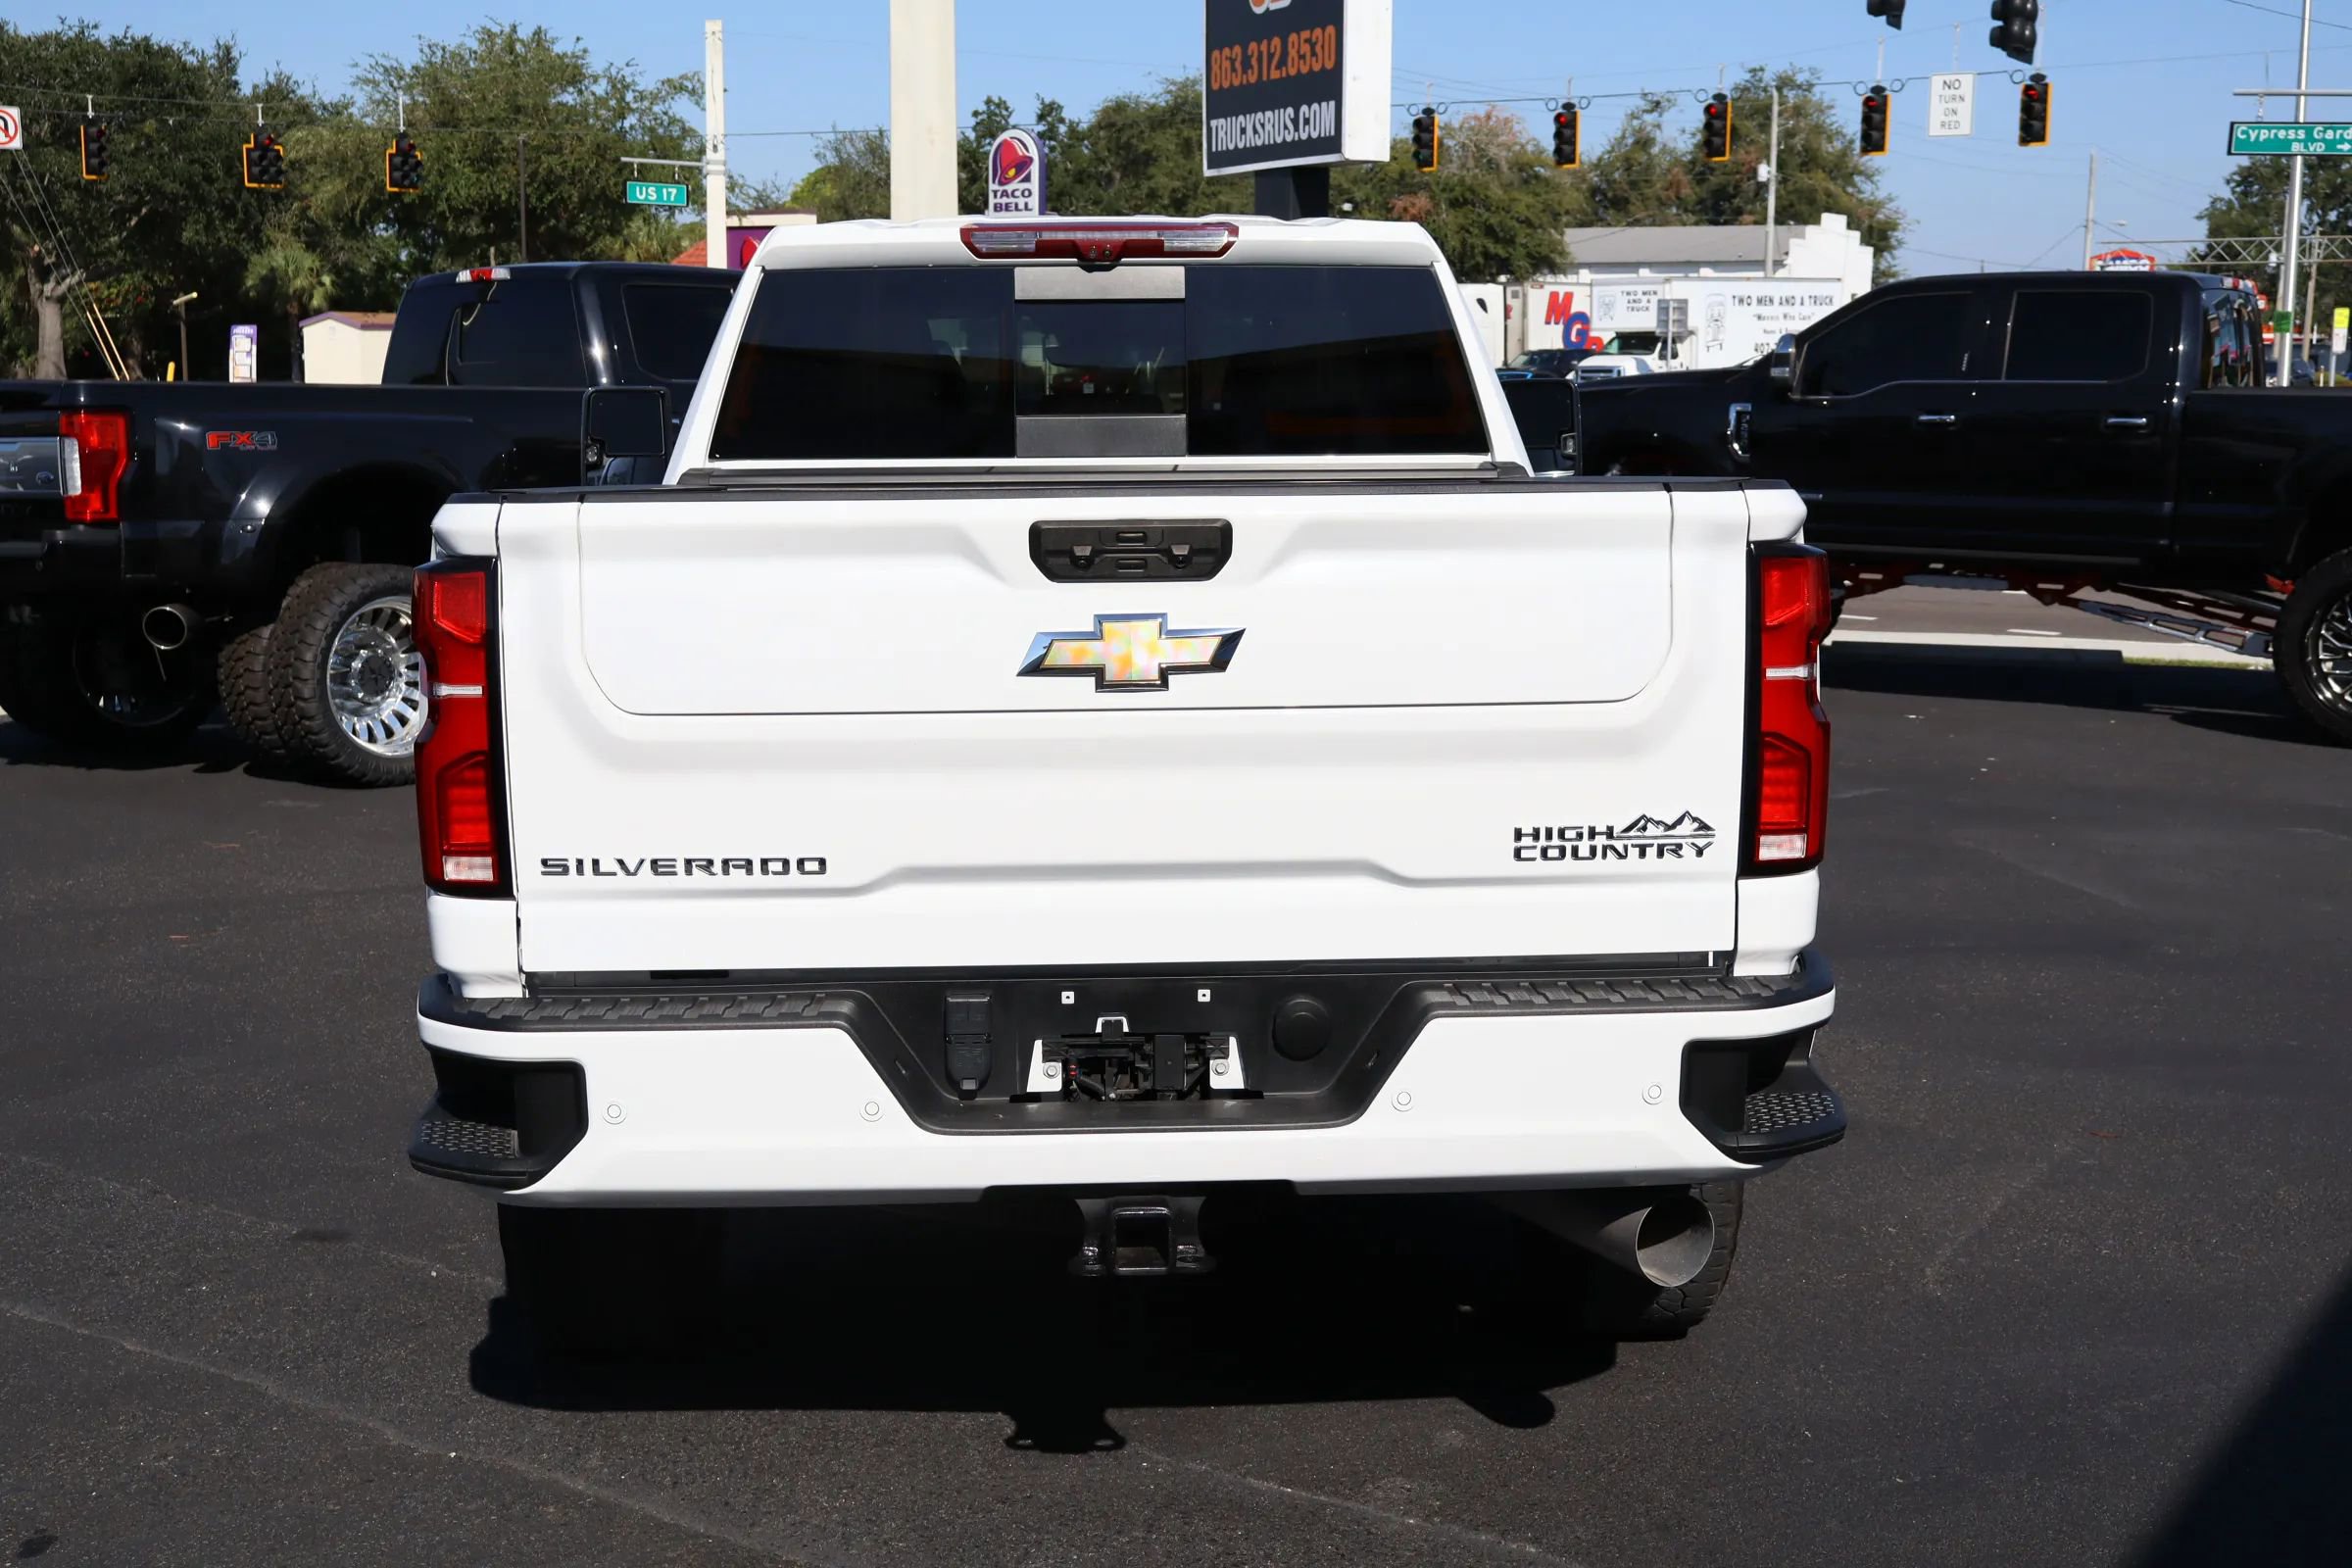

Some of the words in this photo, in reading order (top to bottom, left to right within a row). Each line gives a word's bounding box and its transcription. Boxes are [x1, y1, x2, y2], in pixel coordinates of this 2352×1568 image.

[1210, 24, 1337, 91] 863.312.8530
[1942, 78, 1962, 90] NO
[1937, 94, 1965, 104] TURN
[1944, 107, 1957, 117] ON
[1209, 100, 1336, 152] TRUCKSRUS.COM
[1940, 121, 1960, 129] RED
[2236, 125, 2306, 141] Cypress
[2290, 141, 2326, 152] BLVD
[635, 185, 658, 200] US
[662, 187, 677, 202] 17
[991, 188, 1033, 199] TACO
[993, 202, 1033, 213] BELL
[1732, 295, 1752, 306] TWO
[1757, 295, 1774, 306] MEN
[1779, 295, 1795, 306] AND
[1800, 295, 1804, 306] A
[1808, 295, 1835, 306] TRUCK
[206, 431, 277, 450] FX4
[1514, 825, 1615, 843] HIGH
[1513, 841, 1715, 861] COUNTRY
[540, 858, 827, 876] SILVERADO
